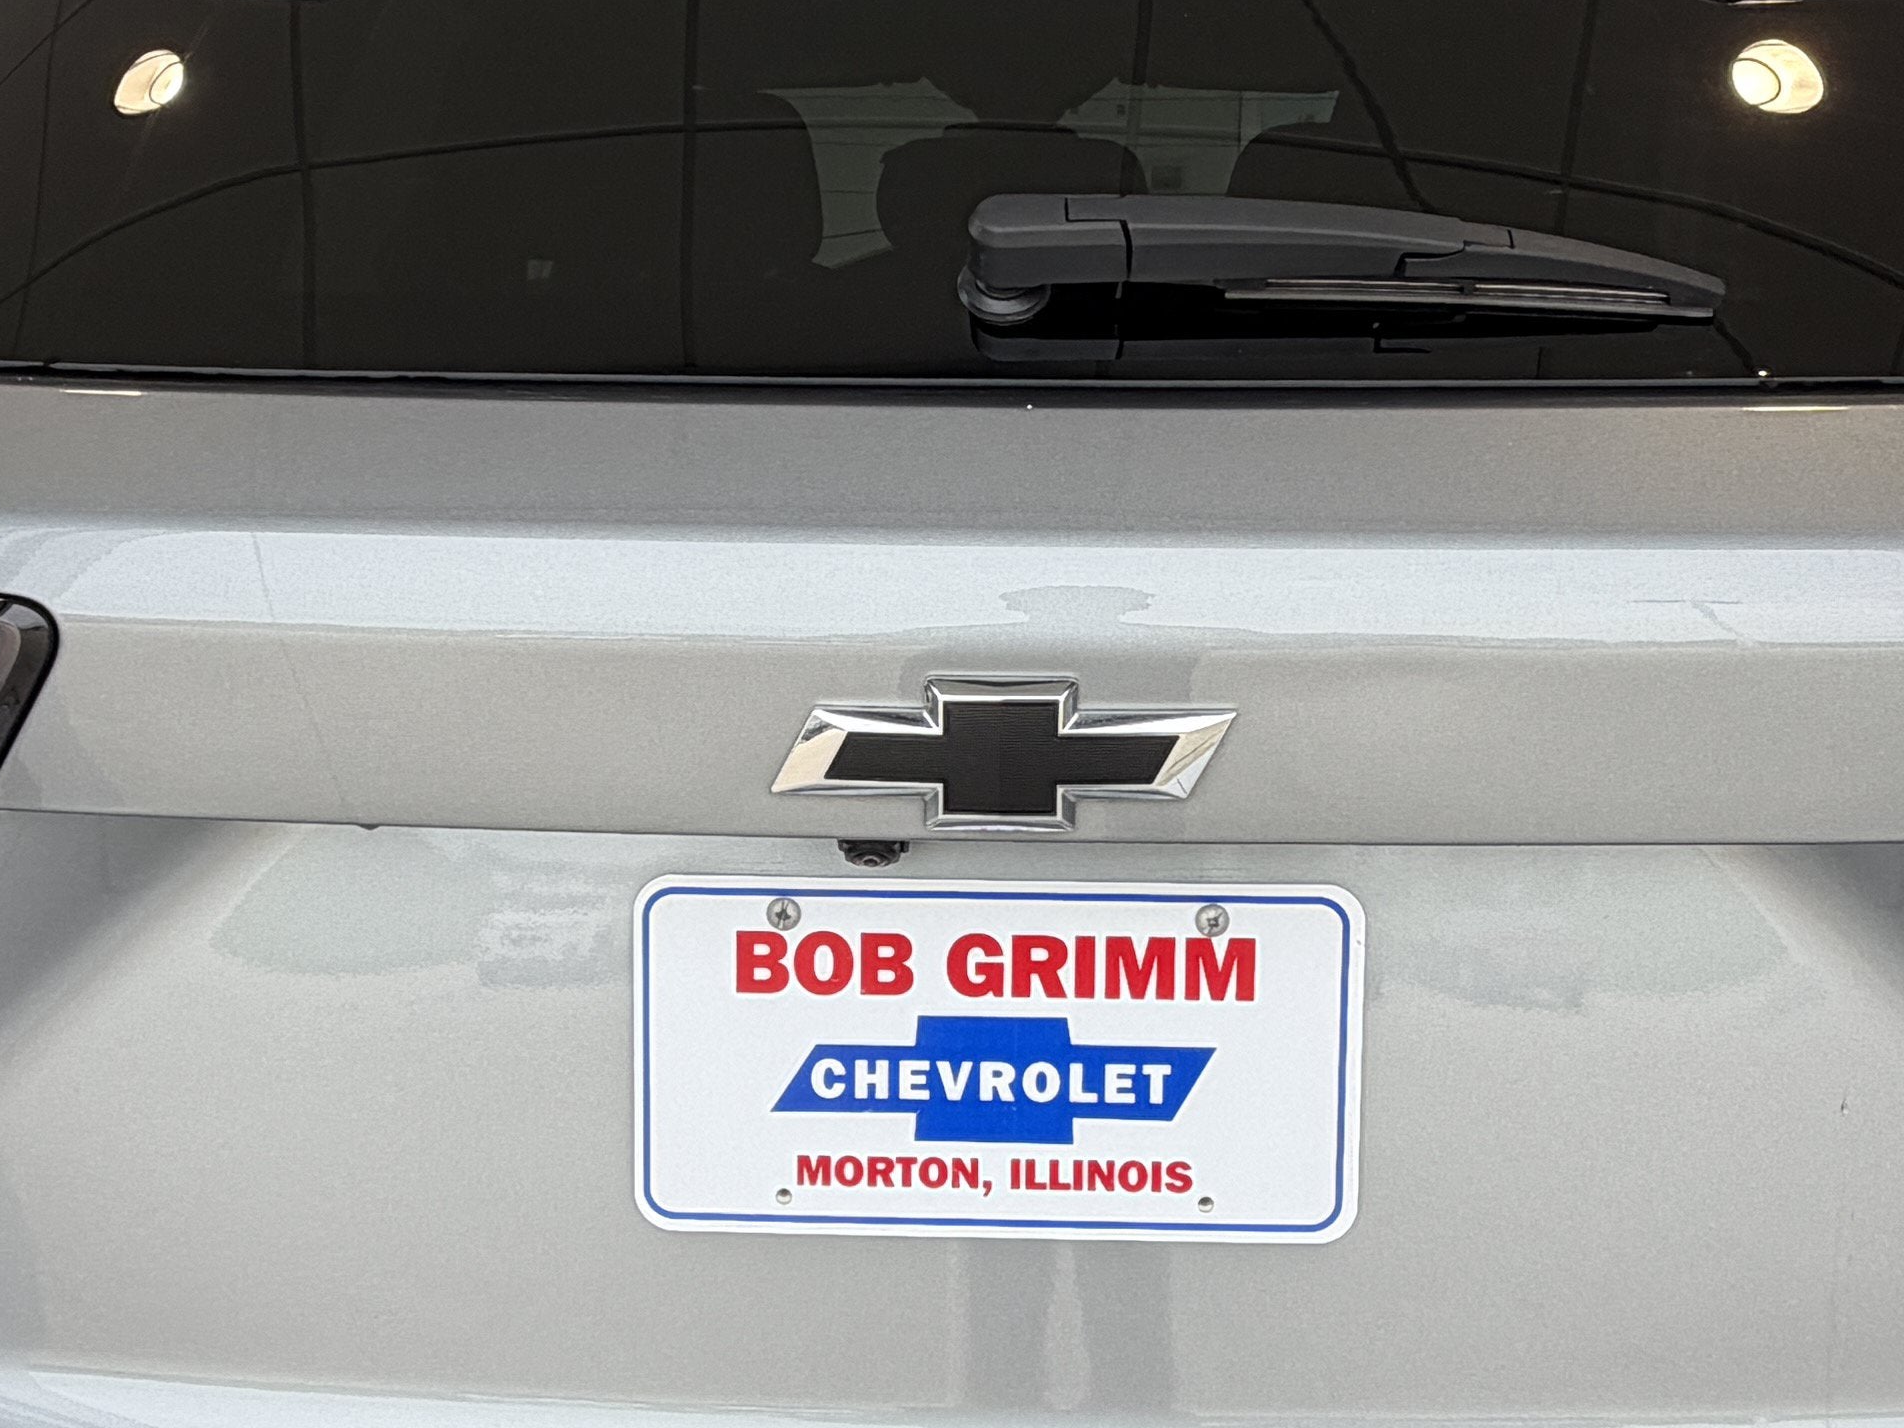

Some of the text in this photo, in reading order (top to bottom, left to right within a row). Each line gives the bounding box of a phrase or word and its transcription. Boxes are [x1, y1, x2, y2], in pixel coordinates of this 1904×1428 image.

[736, 931, 1257, 1002] BOB GRIMM
[810, 1058, 1173, 1105] CHEVROLET
[797, 1155, 1193, 1196] MORTON, ILLINOIS
